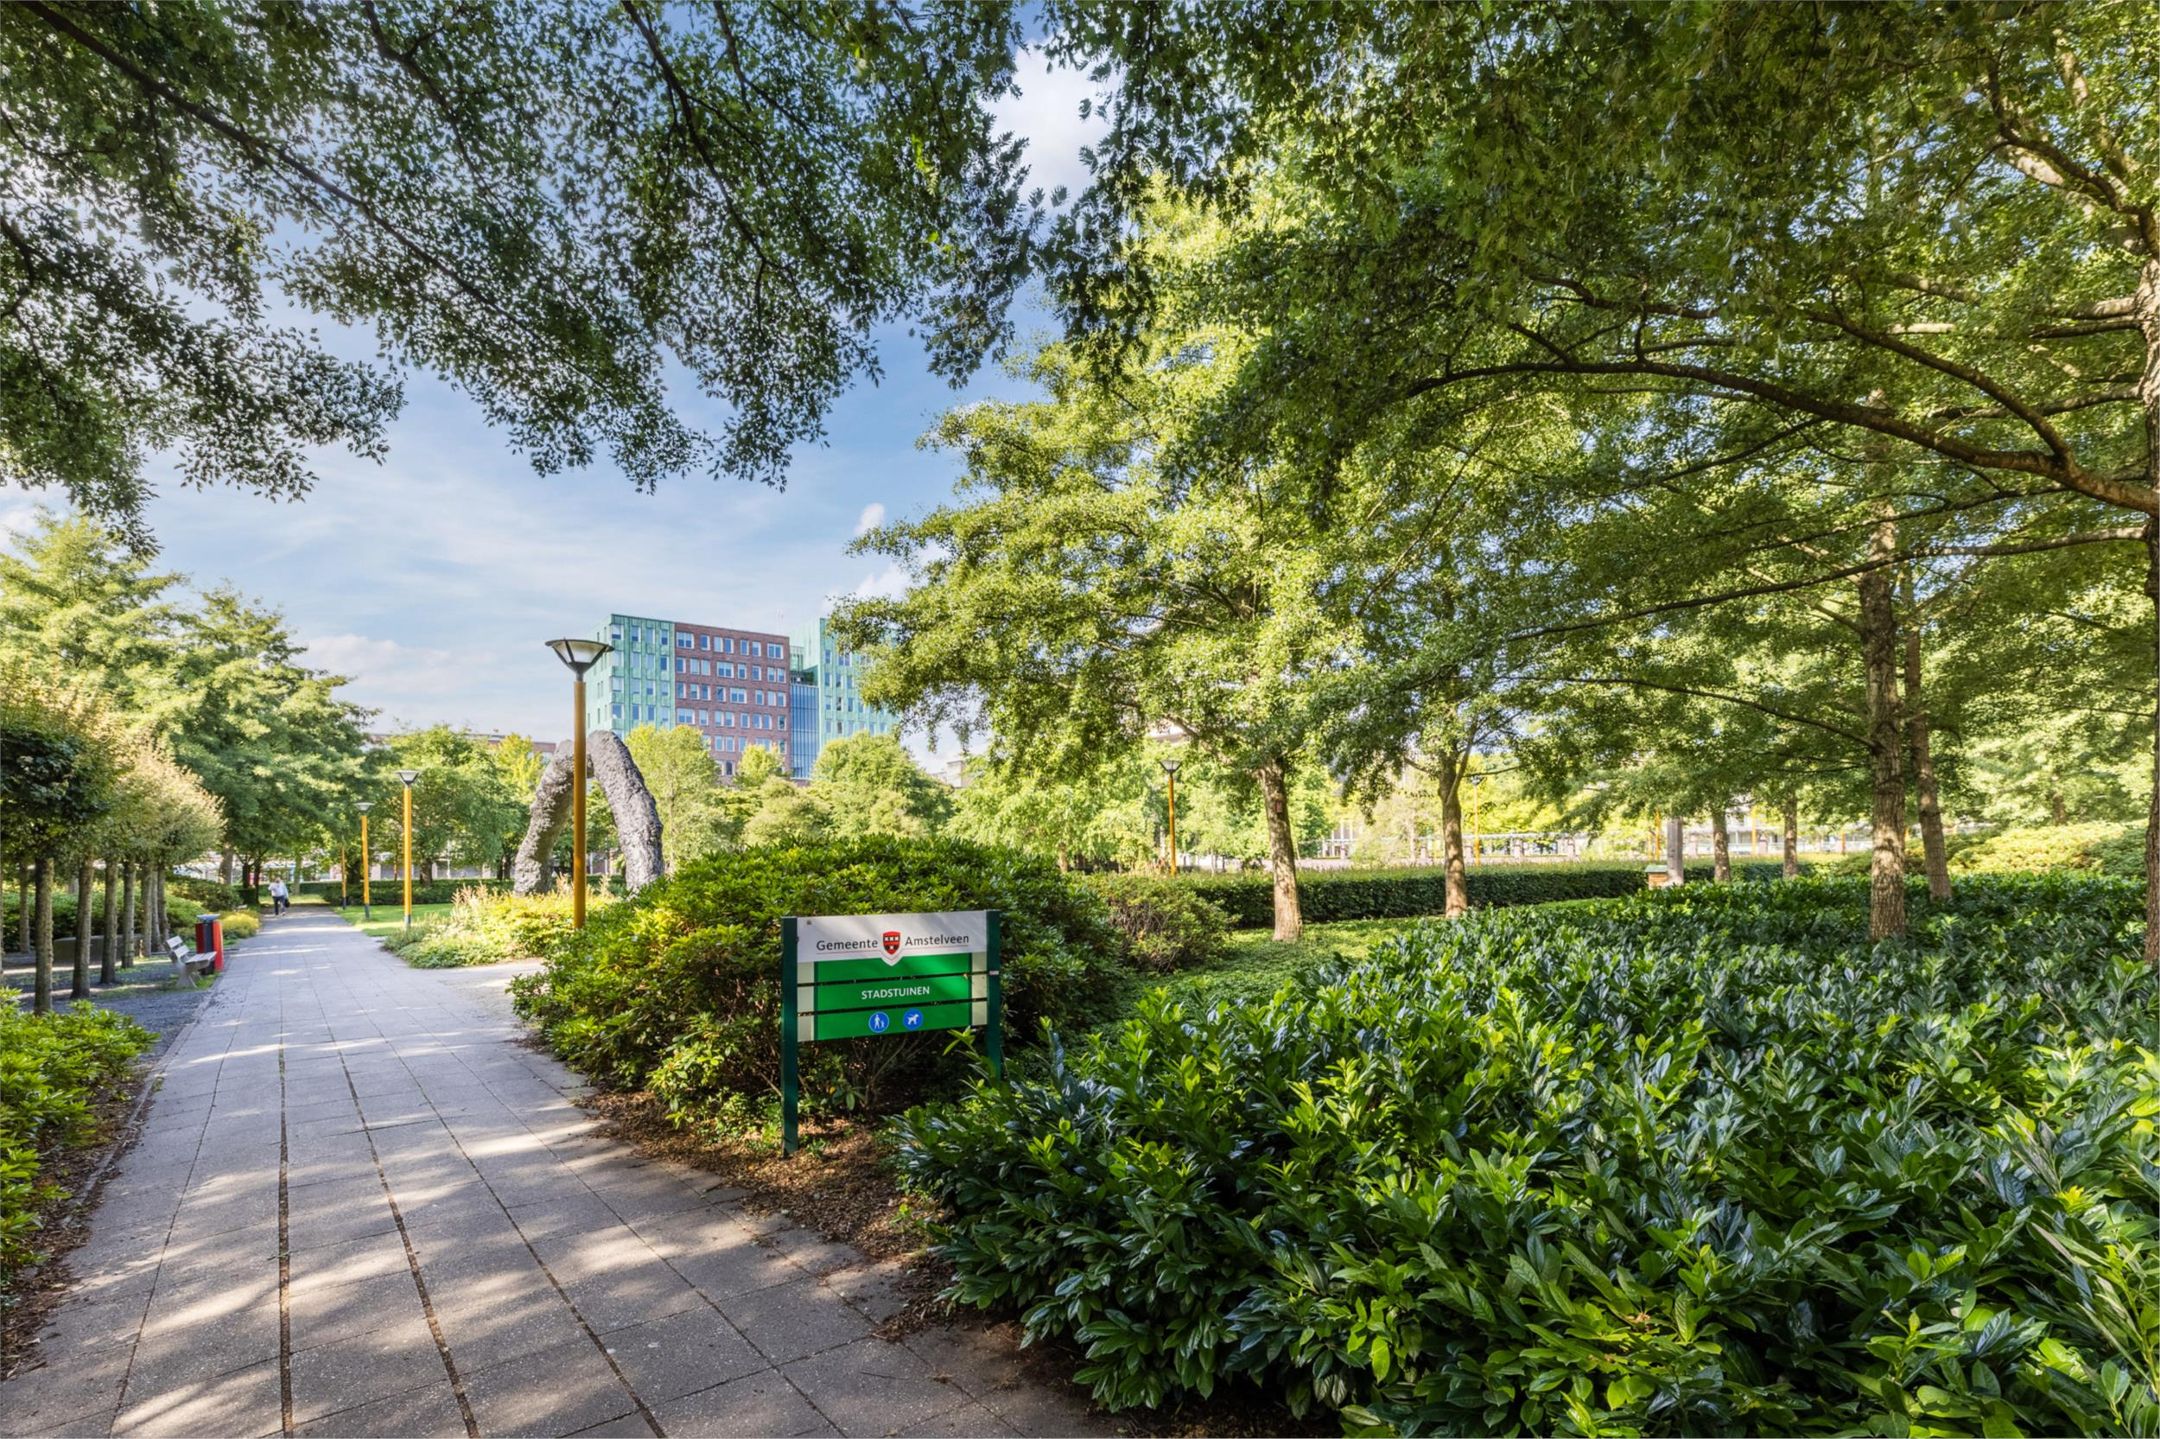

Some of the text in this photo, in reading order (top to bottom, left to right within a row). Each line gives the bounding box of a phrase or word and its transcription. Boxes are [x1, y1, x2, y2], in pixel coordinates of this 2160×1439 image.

[816, 934, 969, 951] Gemeente Amstelveen
[861, 986, 930, 1000] STADSTUINEN
